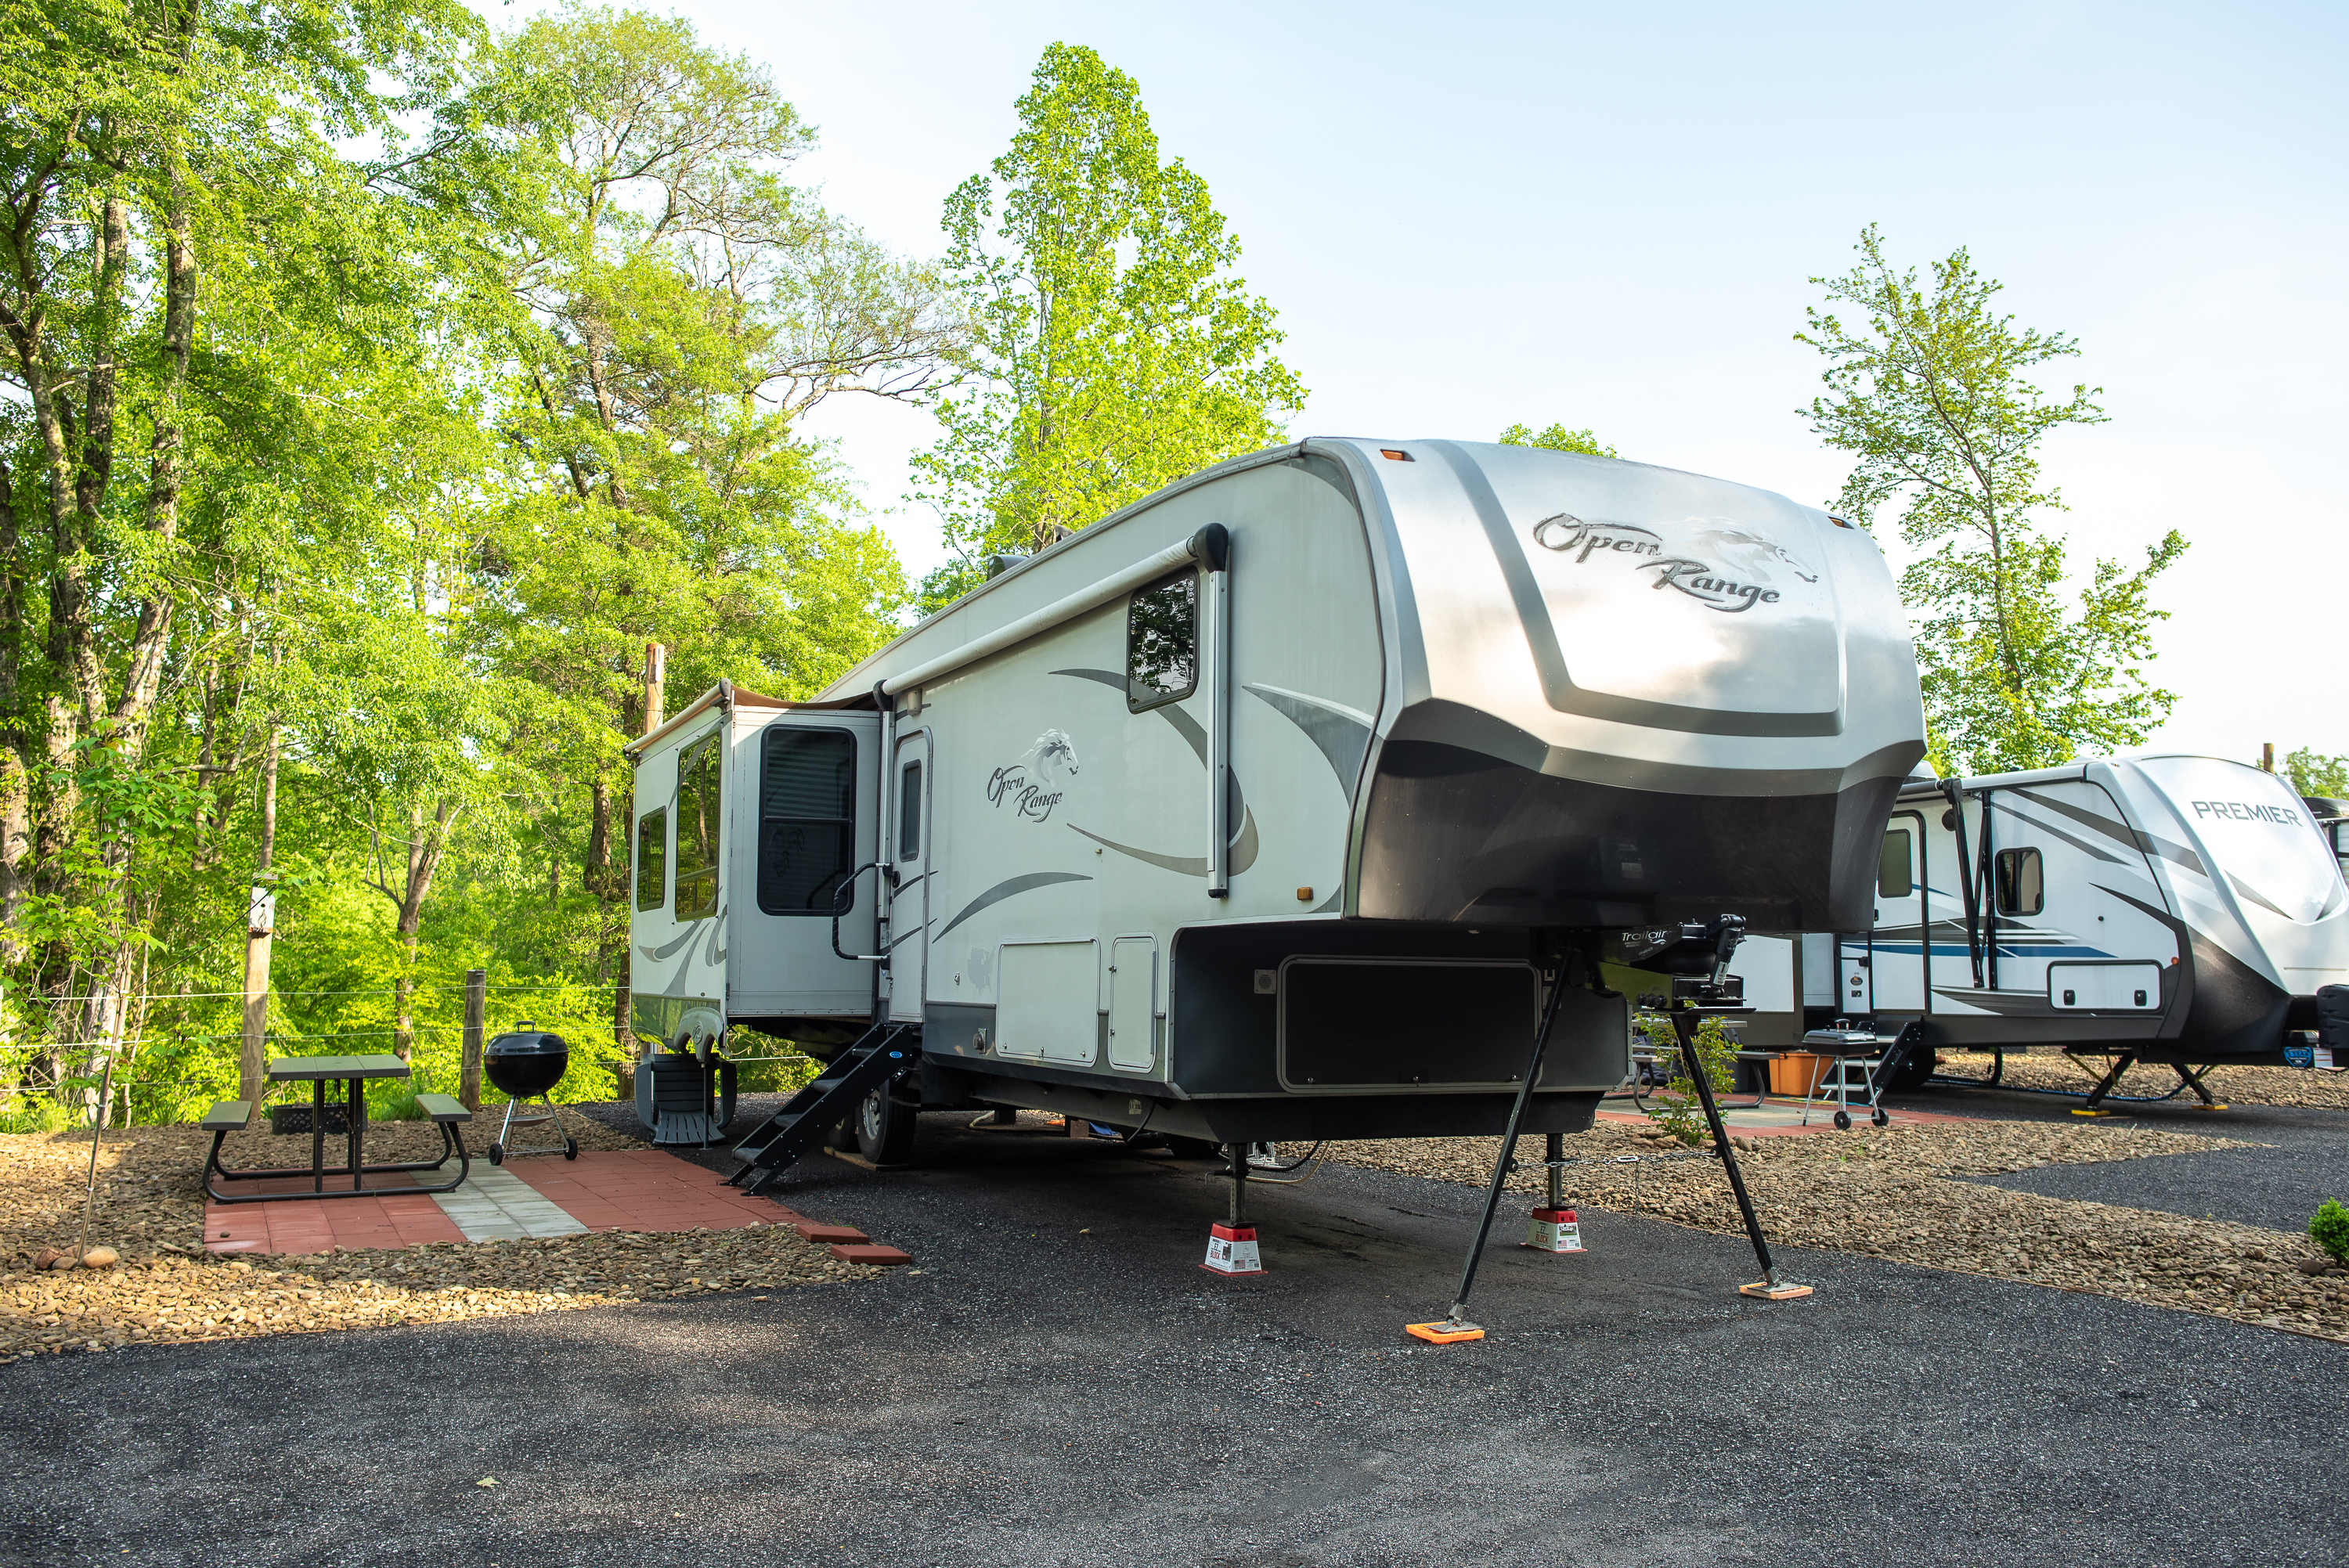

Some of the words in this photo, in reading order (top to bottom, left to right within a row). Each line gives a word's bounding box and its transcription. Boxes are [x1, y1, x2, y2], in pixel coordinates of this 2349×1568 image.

[1532, 512, 1663, 564] Open
[1635, 558, 1781, 613] Range
[987, 765, 1027, 809] Open
[1013, 784, 1063, 824] Range
[2191, 801, 2304, 827] PREMIER
[1210, 1250, 1221, 1260] BLOCK
[1535, 1233, 1550, 1245] BLOCK
